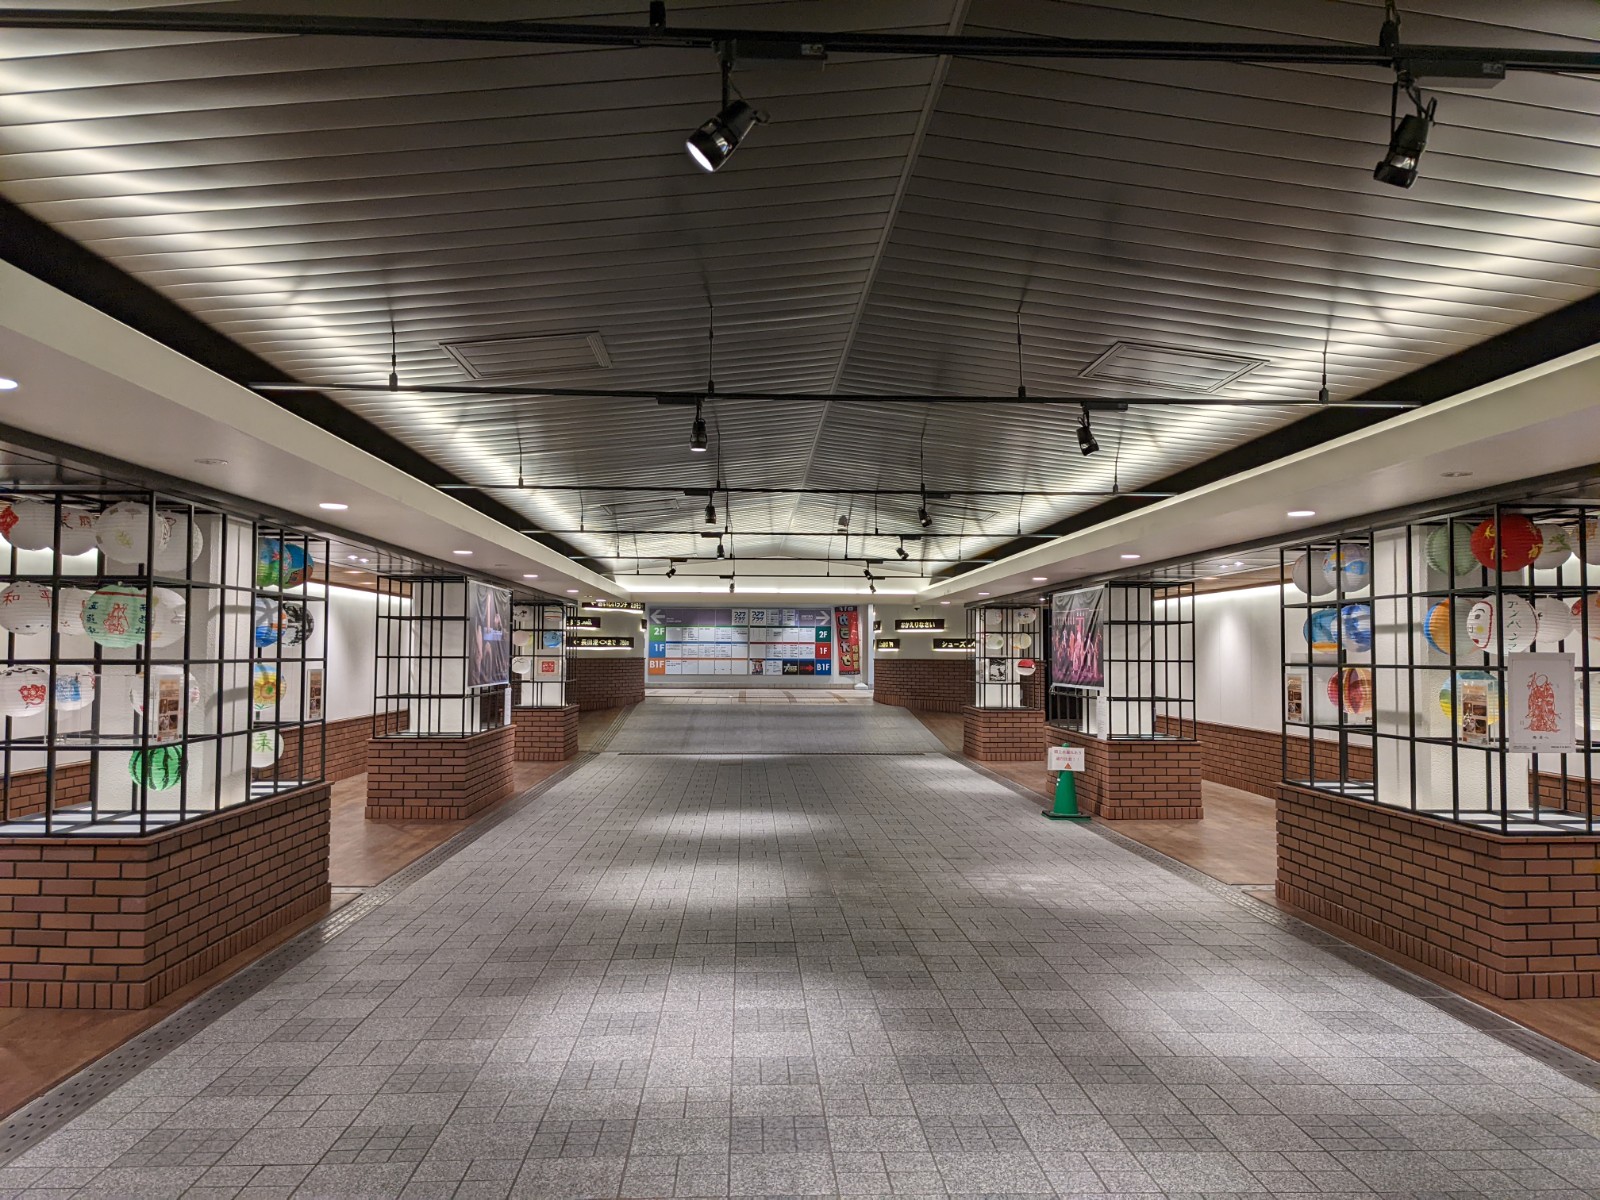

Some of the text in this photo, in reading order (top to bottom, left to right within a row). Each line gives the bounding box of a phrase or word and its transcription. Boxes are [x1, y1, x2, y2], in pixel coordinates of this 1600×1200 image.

[3, 590, 52, 608] 和平
[900, 621, 936, 629] おかえりなさい
[653, 627, 665, 636] 2F
[654, 643, 665, 652] 1F
[941, 640, 967, 648] シューズ
[649, 660, 665, 669] B1F
[816, 663, 830, 671] B1F
